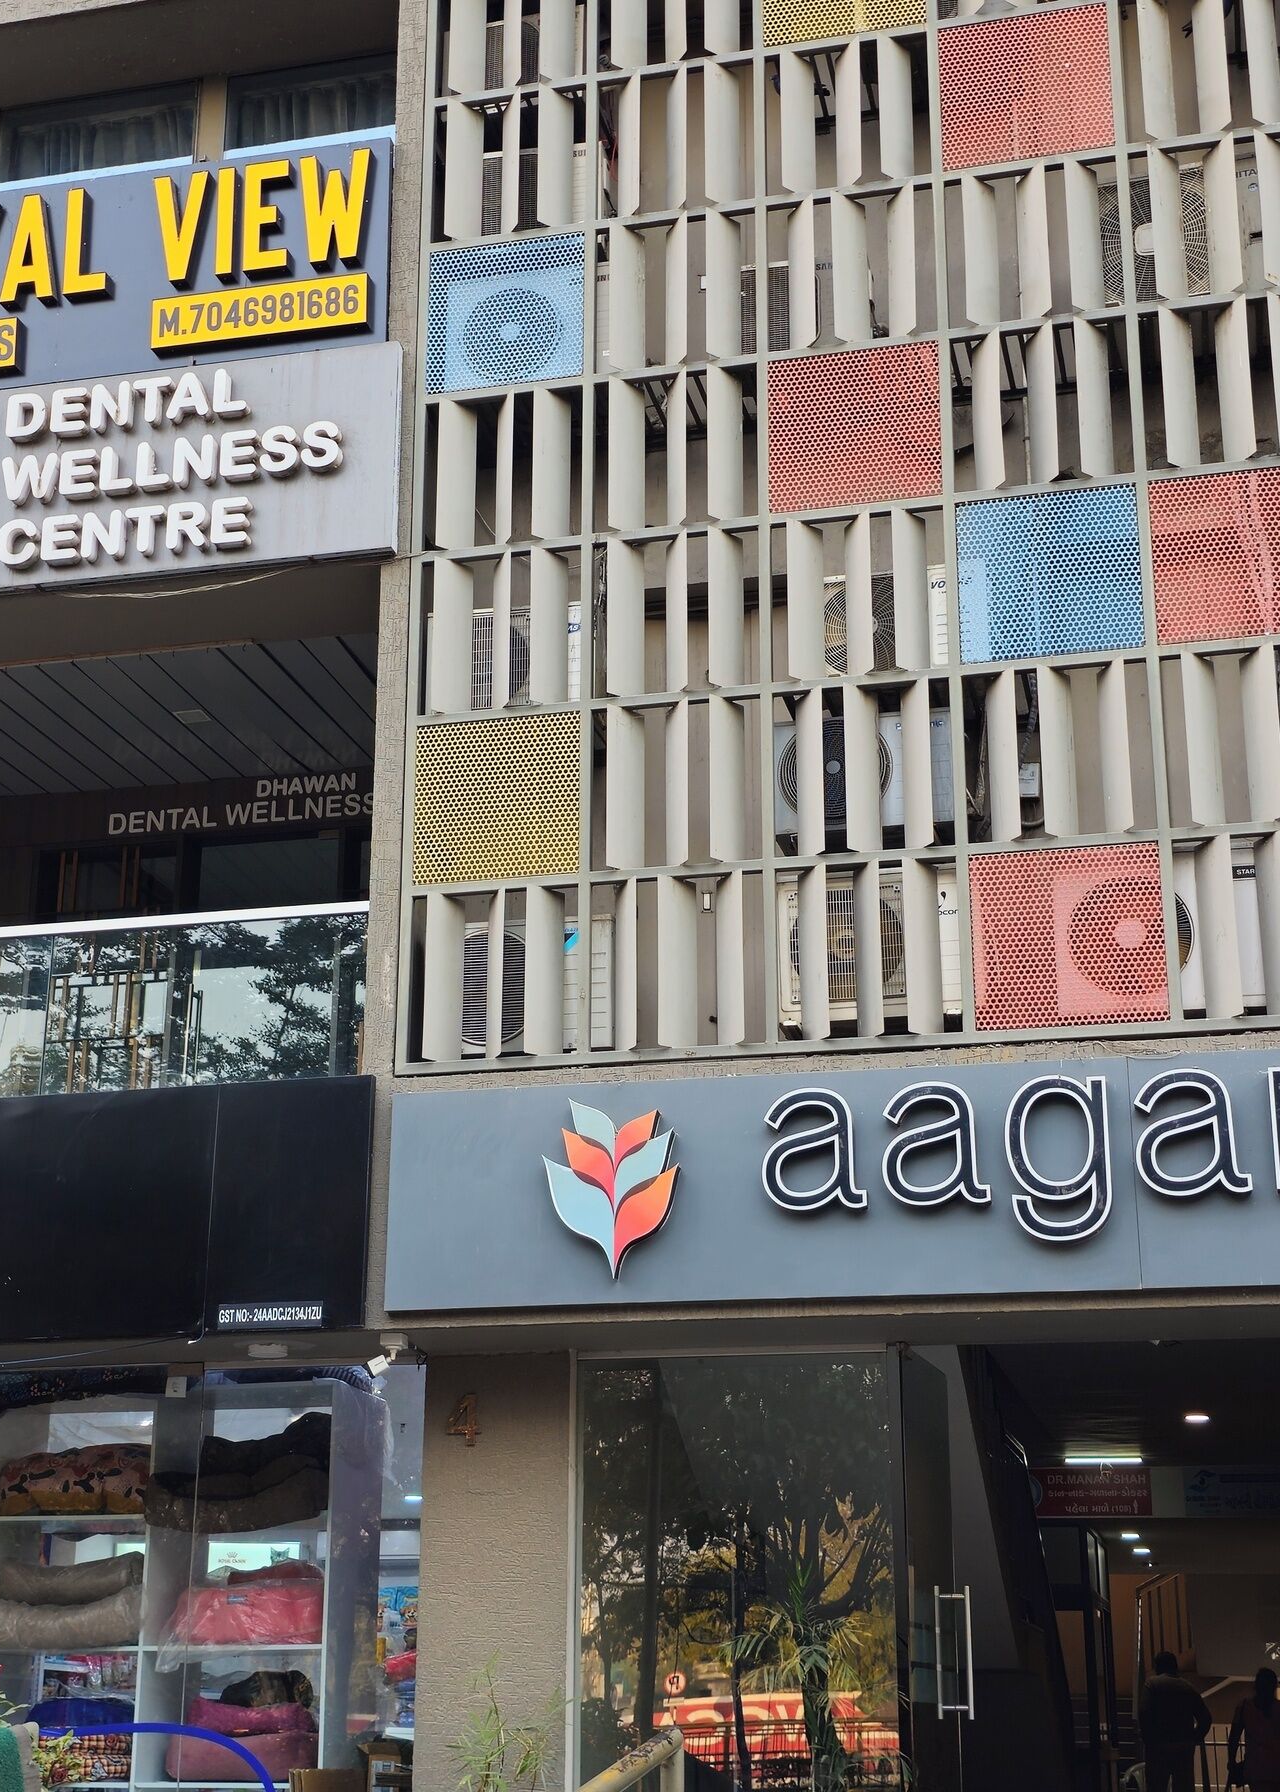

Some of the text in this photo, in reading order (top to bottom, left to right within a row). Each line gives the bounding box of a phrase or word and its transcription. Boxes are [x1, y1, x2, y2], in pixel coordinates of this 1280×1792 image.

[153, 147, 373, 287] VIEW
[159, 283, 361, 338] M.7046981686
[5, 368, 251, 442] DENTAL
[1, 421, 343, 506] WELLNESS
[256, 772, 357, 798] DHAWAN
[108, 806, 217, 835] DENTAL
[219, 1309, 235, 1323] GST
[446, 1393, 482, 1447] 4
[1113, 1474, 1146, 1485] SHAH
